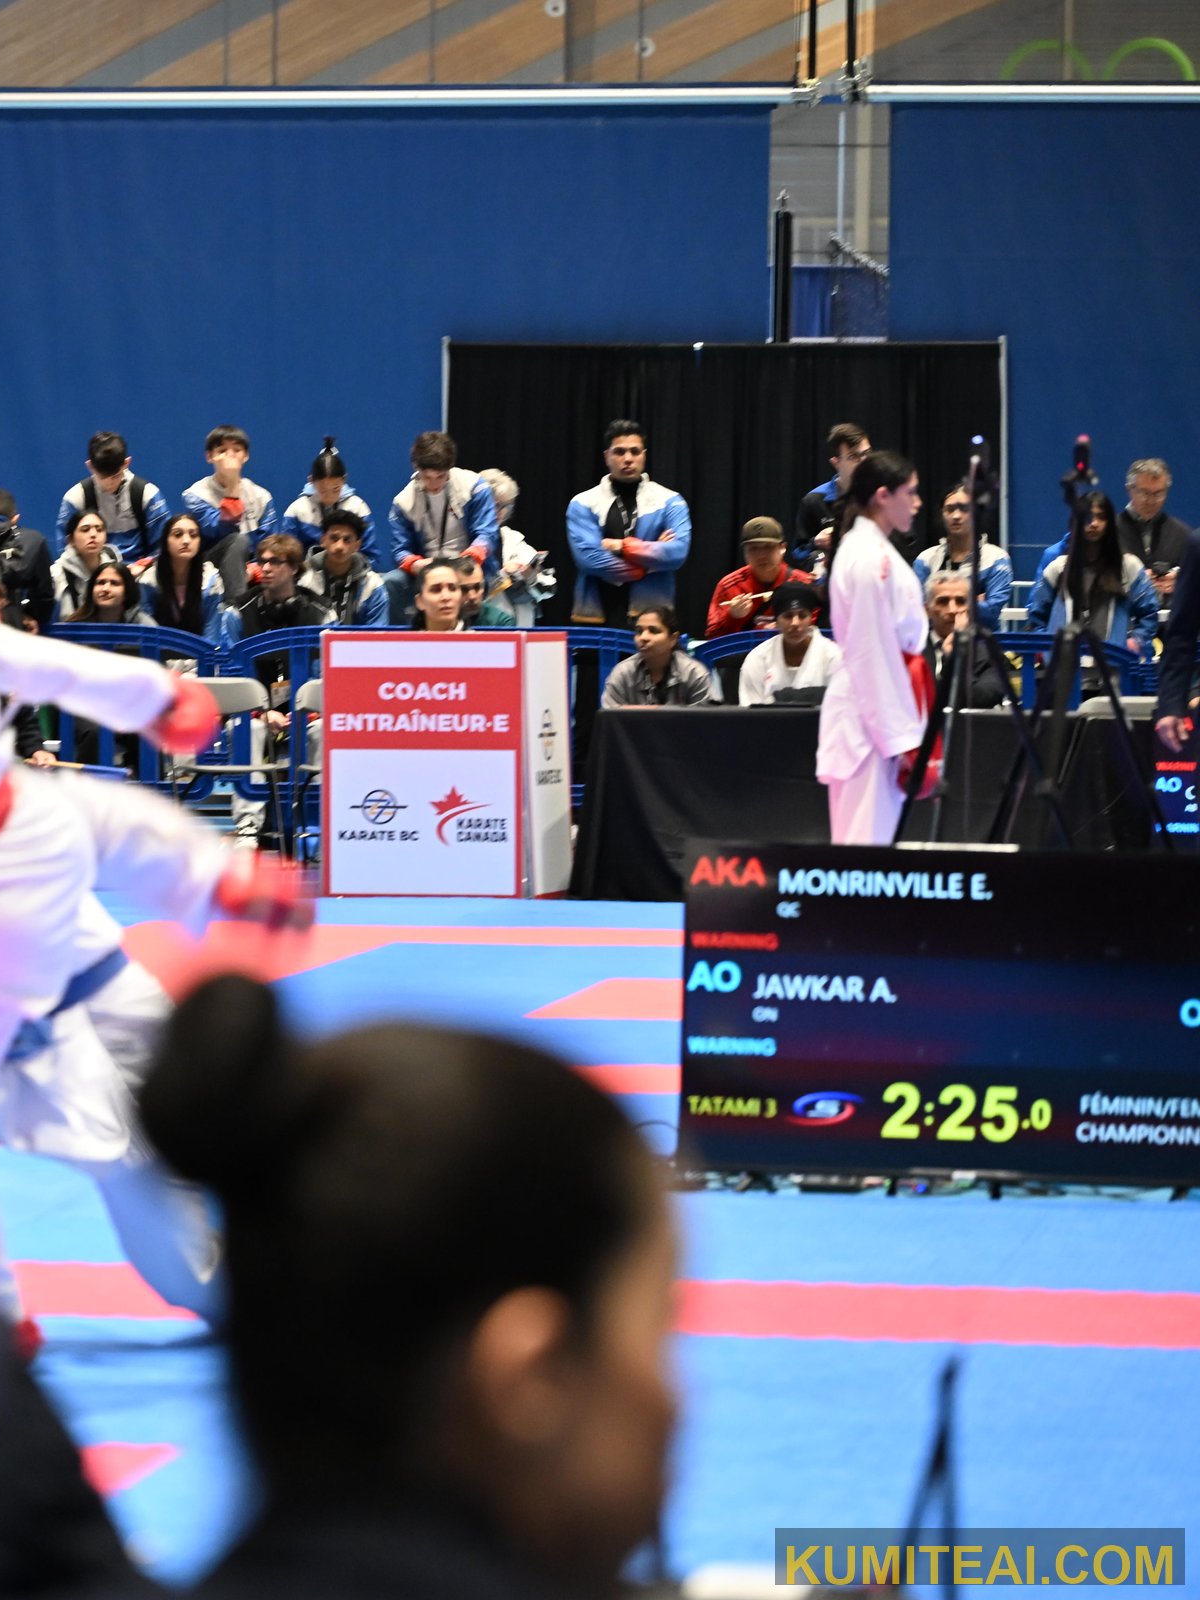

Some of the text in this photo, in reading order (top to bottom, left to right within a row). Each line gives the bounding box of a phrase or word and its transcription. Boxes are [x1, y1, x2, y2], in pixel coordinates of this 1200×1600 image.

[378, 682, 467, 701] COACH
[457, 818, 508, 830] KARATE
[337, 830, 419, 841] KARATE BC
[457, 831, 508, 843] CANADA
[690, 856, 994, 900] AKA MONRINVILLE E.
[691, 931, 779, 952] WARNING
[686, 960, 898, 1004] AO JAWKAR A.
[752, 1005, 779, 1022] ON
[687, 1036, 777, 1057] WARNING
[688, 1095, 761, 1117] TATAMI
